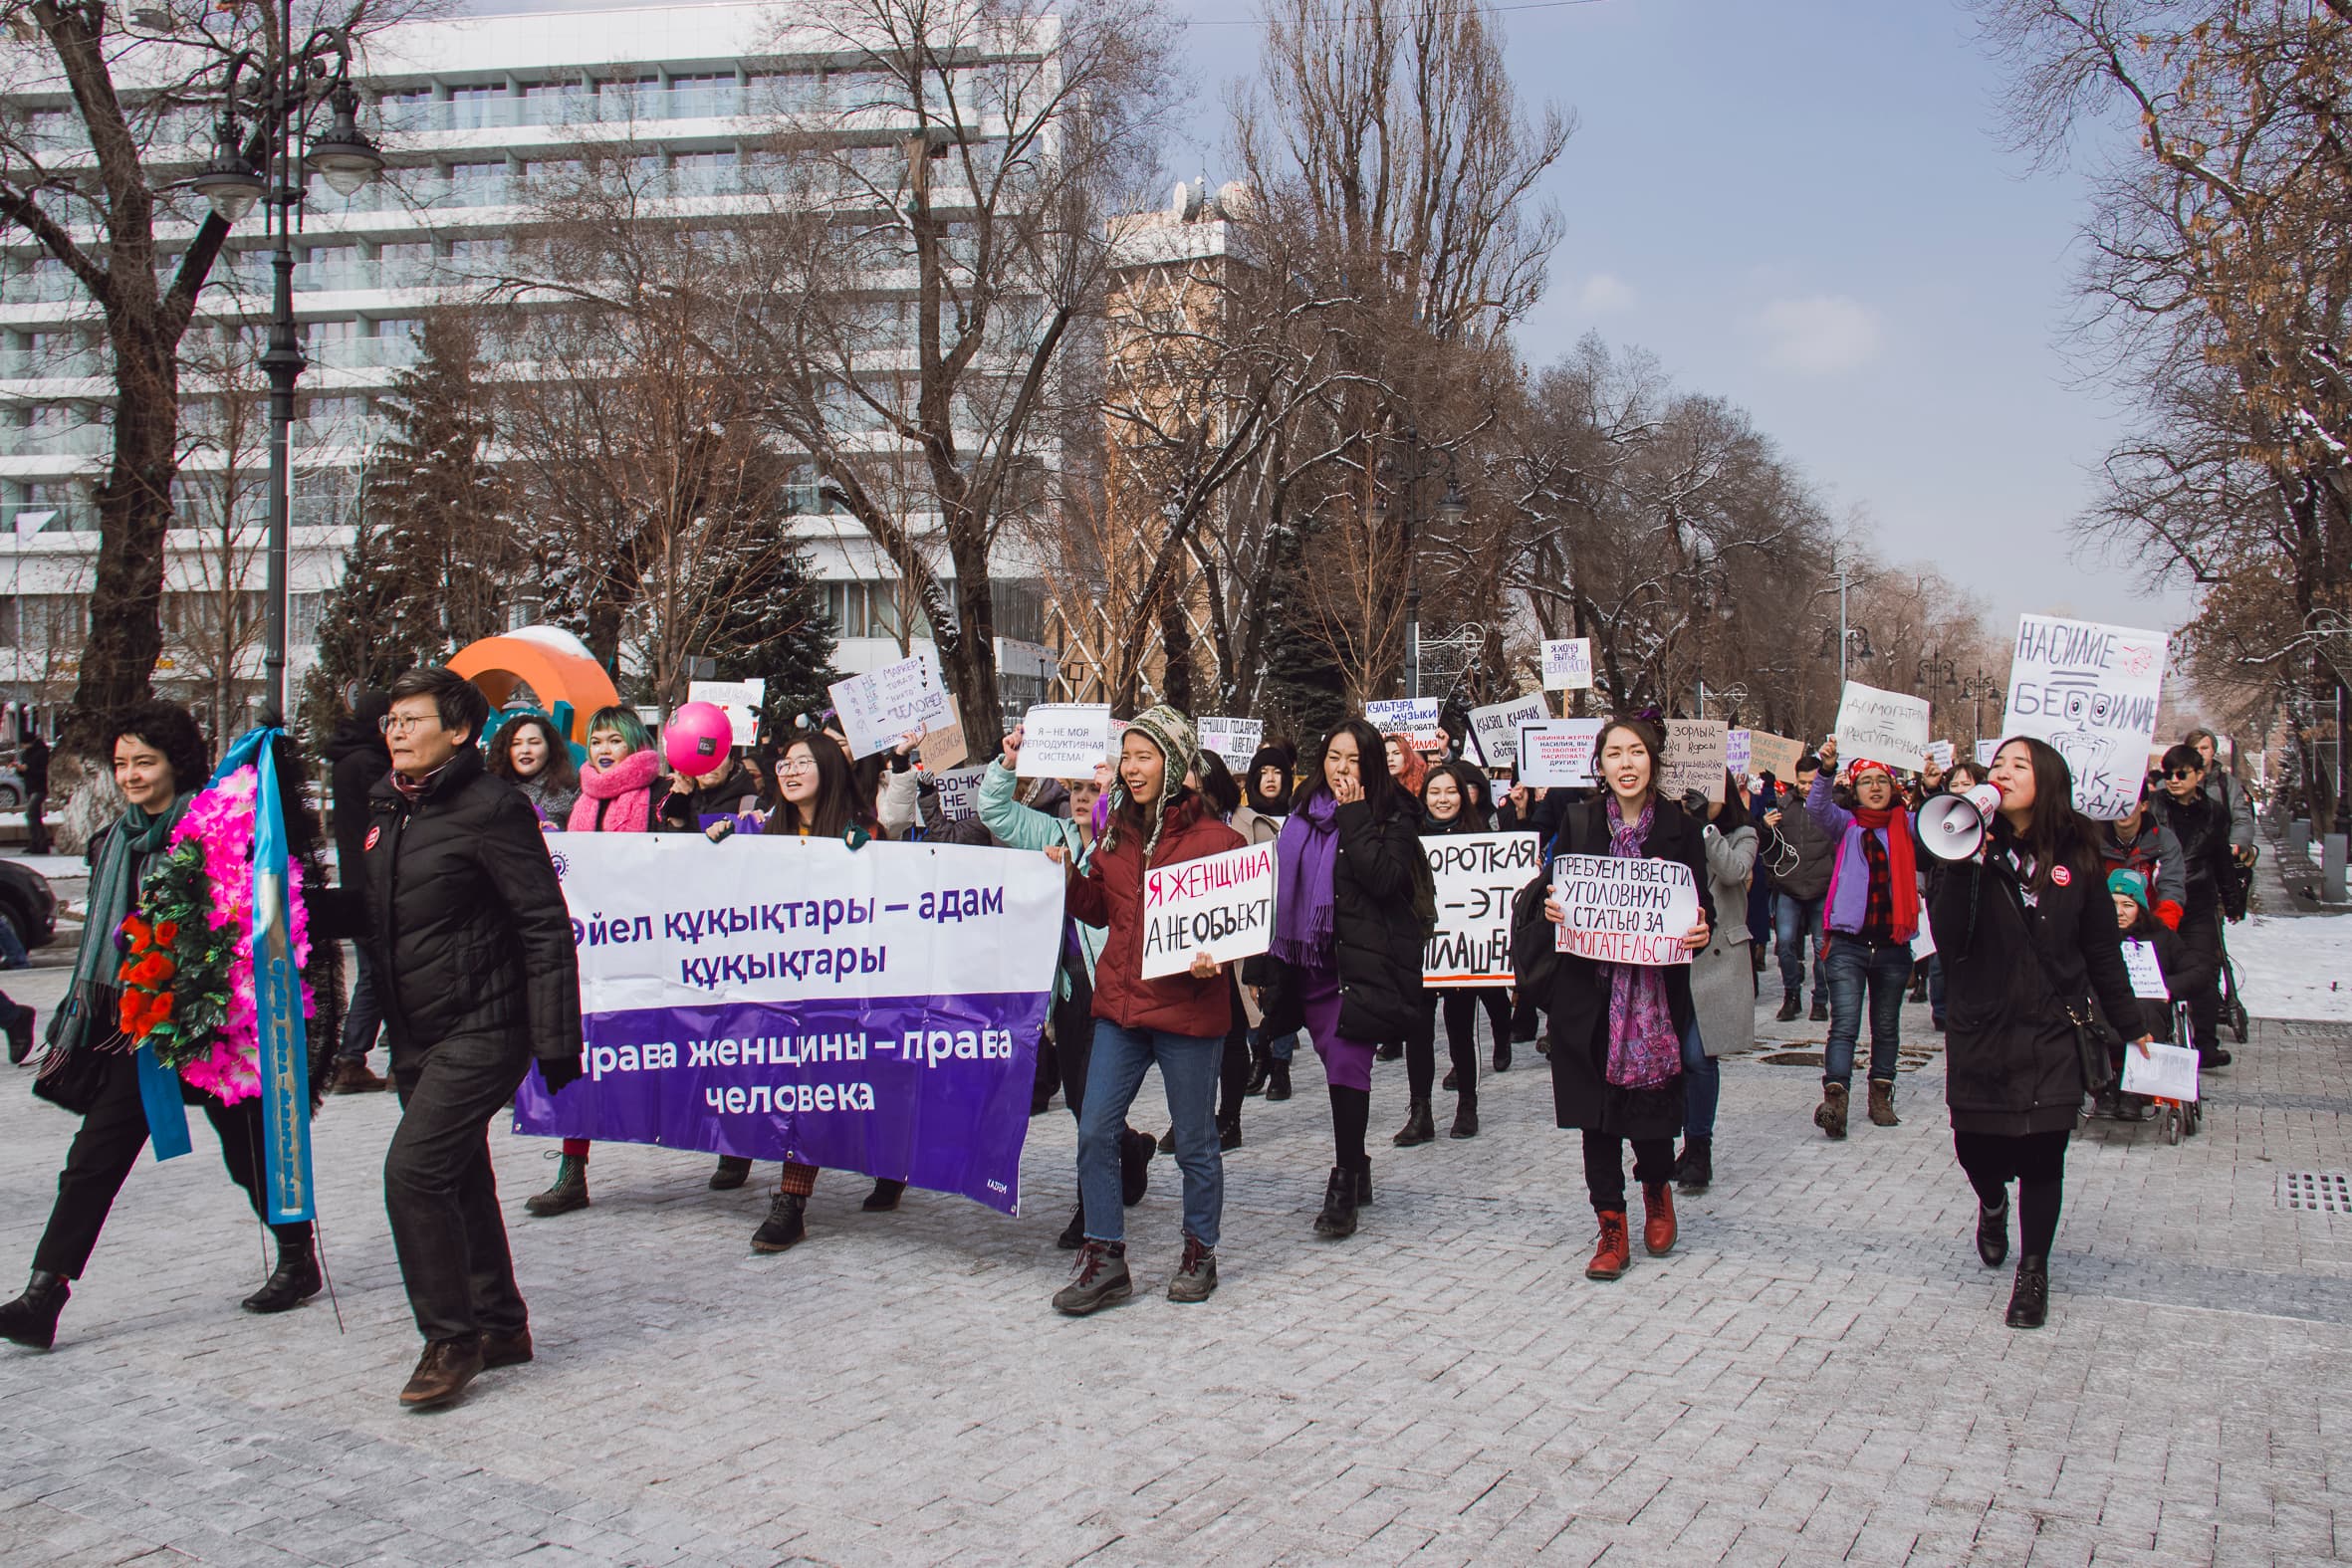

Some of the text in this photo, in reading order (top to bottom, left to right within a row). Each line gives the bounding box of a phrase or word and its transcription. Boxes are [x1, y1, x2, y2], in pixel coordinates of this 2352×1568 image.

[2018, 620, 2118, 670] НАСИЛИЕ
[1367, 700, 1414, 714] КУЛЬТУРА
[1022, 739, 1104, 751] РЕПРОДУКТИВНАЯ
[1038, 728, 1044, 737] Я
[1054, 728, 1064, 737] НЕ
[1067, 728, 1089, 737] МОЯ
[1038, 752, 1084, 762] СИСТЕМА!
[943, 793, 968, 807] НЕ
[1429, 839, 1535, 875] ОРОТКАЯ
[1554, 856, 1692, 887] ТРЕБУЕМ ВВЕСТИ
[1147, 850, 1272, 909] Я ЖЕНЩИНА
[1564, 879, 1671, 909] УГОЛОВНУЮ
[664, 897, 875, 945] құқықтары
[918, 886, 1004, 924] адам
[1145, 898, 1271, 958] А НЕ ОБЪЕКТ
[1573, 906, 1664, 934] СТАТЬЮ ЗА
[681, 946, 886, 991] құқықтары
[687, 1031, 867, 1068] женщины
[902, 1028, 1013, 1069] права
[705, 1082, 875, 1115] человека
